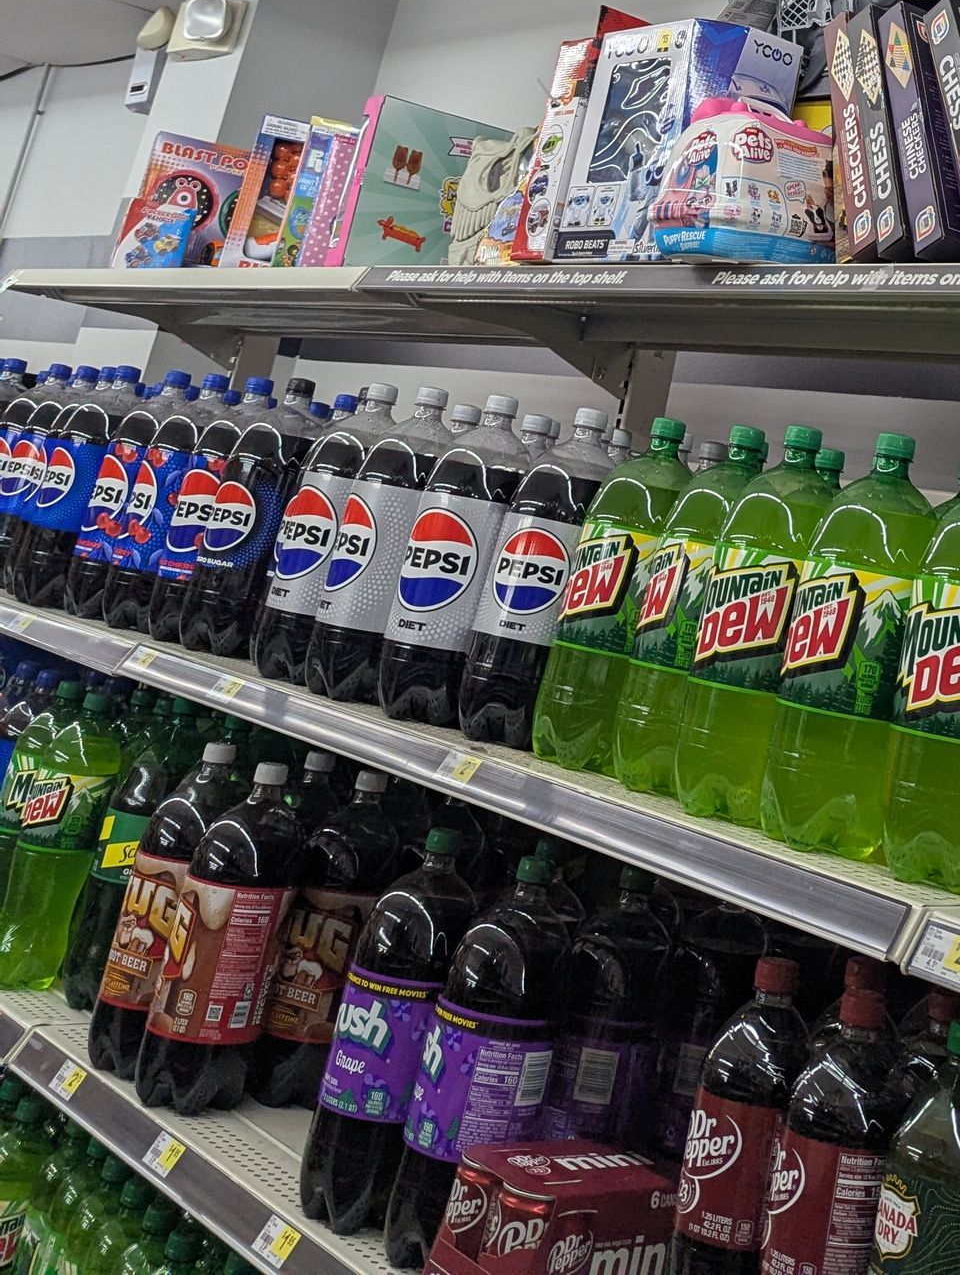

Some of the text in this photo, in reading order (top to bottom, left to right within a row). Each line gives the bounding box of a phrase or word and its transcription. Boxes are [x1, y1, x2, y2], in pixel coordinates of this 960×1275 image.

[734, 128, 773, 150] Pets
[910, 111, 927, 174] CHECKERS
[162, 141, 217, 164] BLAST
[740, 145, 773, 161] Alive
[843, 103, 867, 208] CHECKERS
[902, 117, 918, 180] CHINESE
[871, 121, 891, 200] CHESS
[565, 240, 584, 250] ROBO
[663, 231, 706, 246] PUPPY RESCUE
[386, 270, 625, 286] Please ask for help with items on the top shelf.
[712, 271, 760, 286] Please
[760, 271, 788, 285] ask
[788, 271, 814, 286] for
[812, 271, 850, 288] help
[852, 271, 888, 286] with
[888, 270, 937, 286] items
[211, 506, 251, 527] EPSI
[206, 557, 234, 568] SUGAR
[403, 545, 470, 576] PEPSI
[497, 556, 564, 587] PEPSI
[271, 586, 290, 598] DIET
[398, 619, 426, 632] DIET
[499, 620, 526, 632] DIET
[127, 876, 177, 938] UG
[121, 953, 147, 973] BEER
[287, 987, 317, 1005] BEER
[361, 979, 369, 988] TO
[369, 982, 382, 992] WIN
[382, 984, 399, 996] FREE
[334, 1000, 389, 1048] rush
[335, 1050, 366, 1075] Grape
[474, 1073, 518, 1085] Calories 160
[370, 1091, 383, 1101] 160
[554, 1152, 655, 1171] mini
[685, 1137, 735, 1168] epper
[841, 1155, 873, 1166] Nutrition
[651, 1190, 660, 1209] 6
[836, 1187, 866, 1197] Calories
[701, 1211, 733, 1226] 1.25 LITERS
[703, 1220, 731, 1233] 42.2 FL OZ
[701, 1226, 712, 1237] 10.2
[712, 1229, 719, 1239] FL
[719, 1231, 730, 1243] OZ)
[877, 1220, 899, 1246] DRY
[550, 1241, 592, 1274] Pepper
